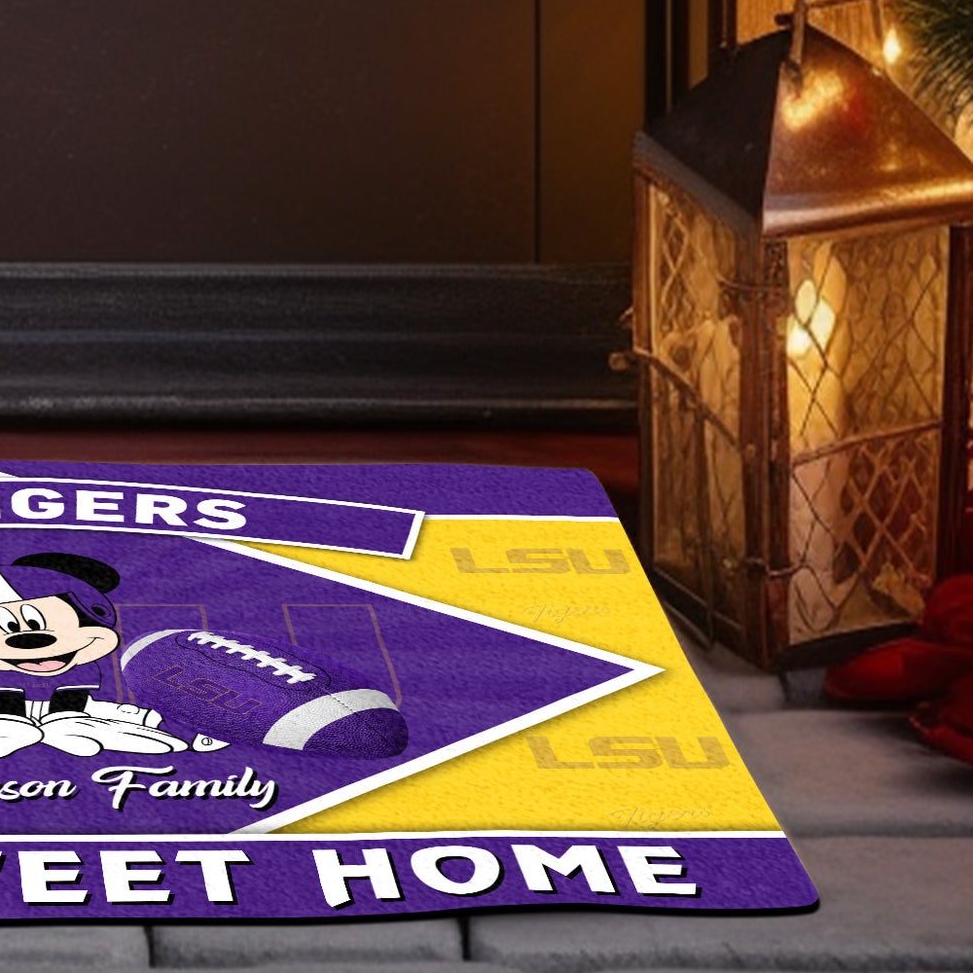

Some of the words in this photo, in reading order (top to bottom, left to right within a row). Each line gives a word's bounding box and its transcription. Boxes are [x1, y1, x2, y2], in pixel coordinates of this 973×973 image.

[450, 547, 631, 574] LSU
[152, 665, 263, 715] LSU
[527, 736, 730, 769] LSU
[91, 766, 277, 811] Family
[312, 844, 701, 909] HOME
